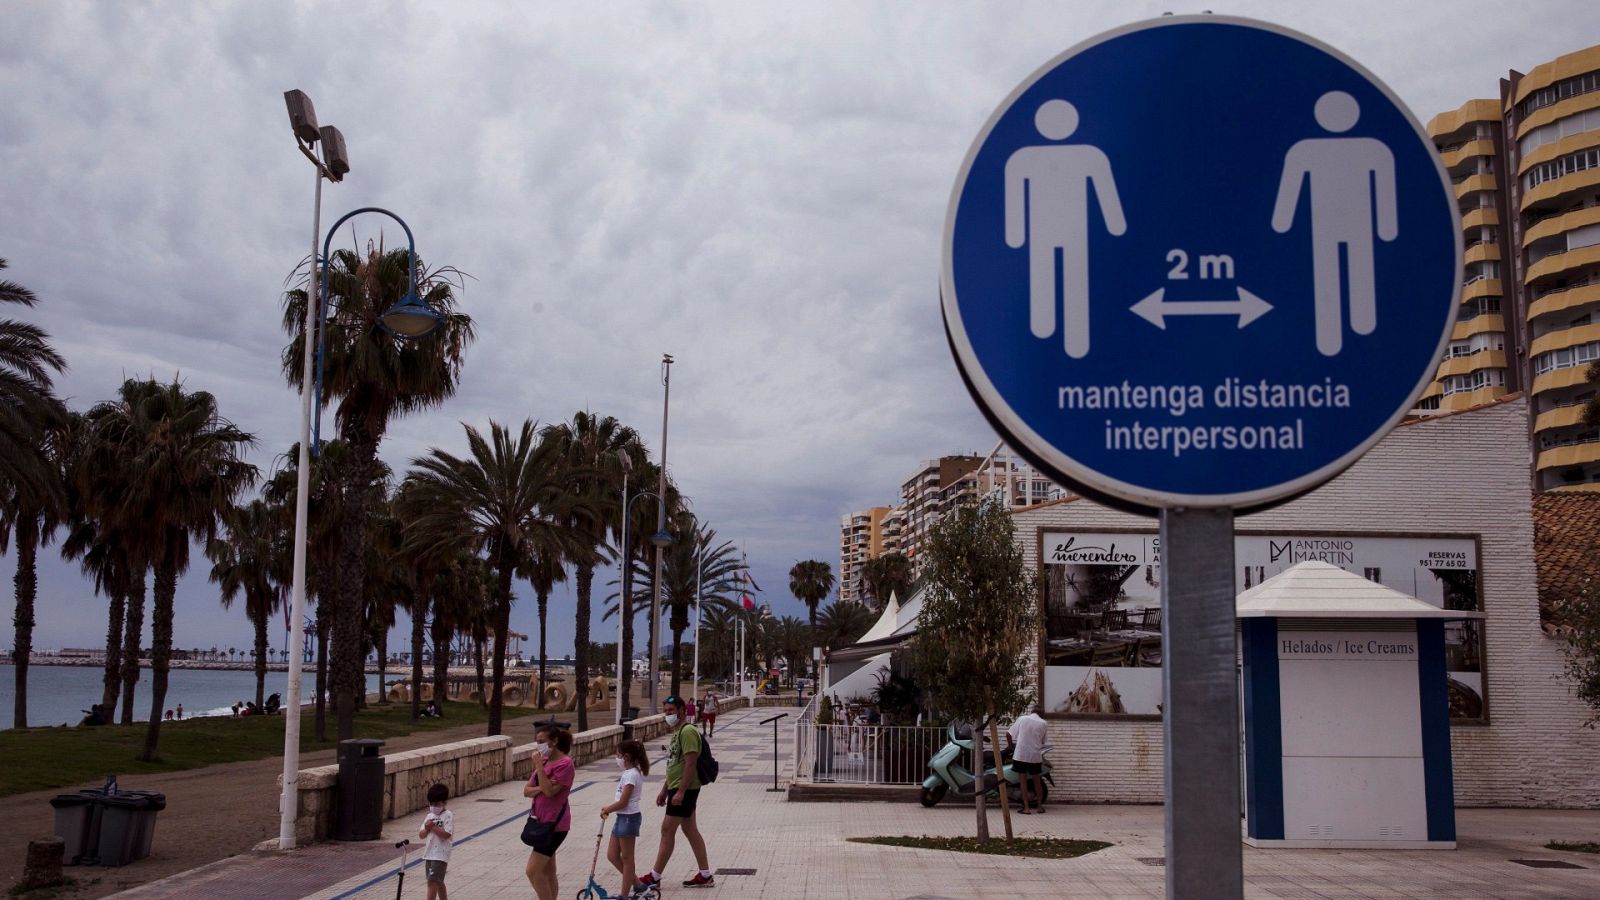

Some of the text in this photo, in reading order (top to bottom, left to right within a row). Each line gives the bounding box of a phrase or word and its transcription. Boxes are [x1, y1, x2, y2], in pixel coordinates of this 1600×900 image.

[1166, 248, 1235, 280] 2 m
[1058, 378, 1350, 416] mantenga distancia
[1105, 418, 1304, 457] interpersonal
[1052, 543, 1136, 562] merendero
[1295, 540, 1353, 550] ANTONIO
[1419, 559, 1432, 567] 951
[1428, 551, 1466, 559] RESERVAS
[1282, 640, 1333, 653] Helados
[1345, 640, 1363, 654] Ice
[1367, 640, 1415, 654] Creams
